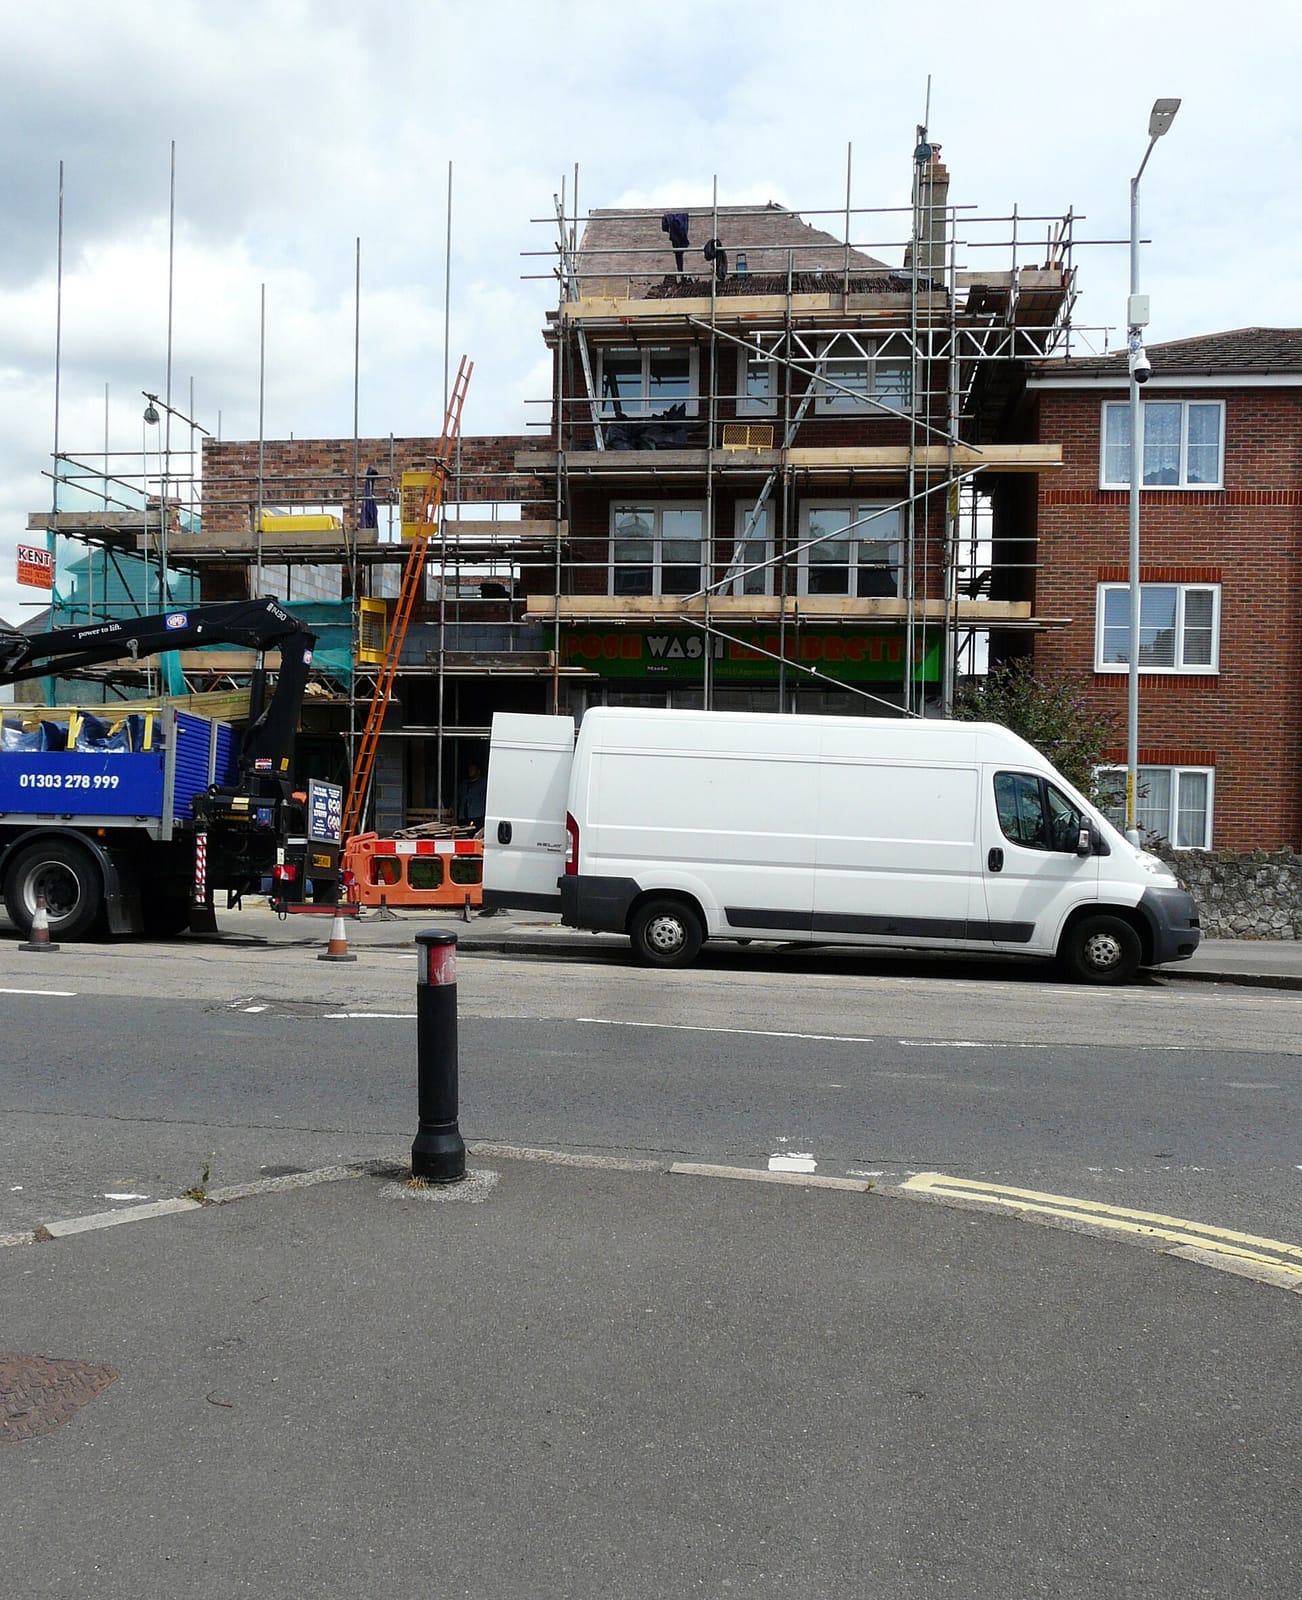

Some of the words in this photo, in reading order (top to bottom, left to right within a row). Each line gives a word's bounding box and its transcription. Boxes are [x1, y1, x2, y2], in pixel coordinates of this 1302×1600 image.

[18, 548, 50, 565] KENT
[78, 629, 100, 640] power
[646, 635, 724, 659] WASH
[20, 774, 61, 788] 01303
[64, 775, 91, 789] 278
[93, 775, 120, 789] 999
